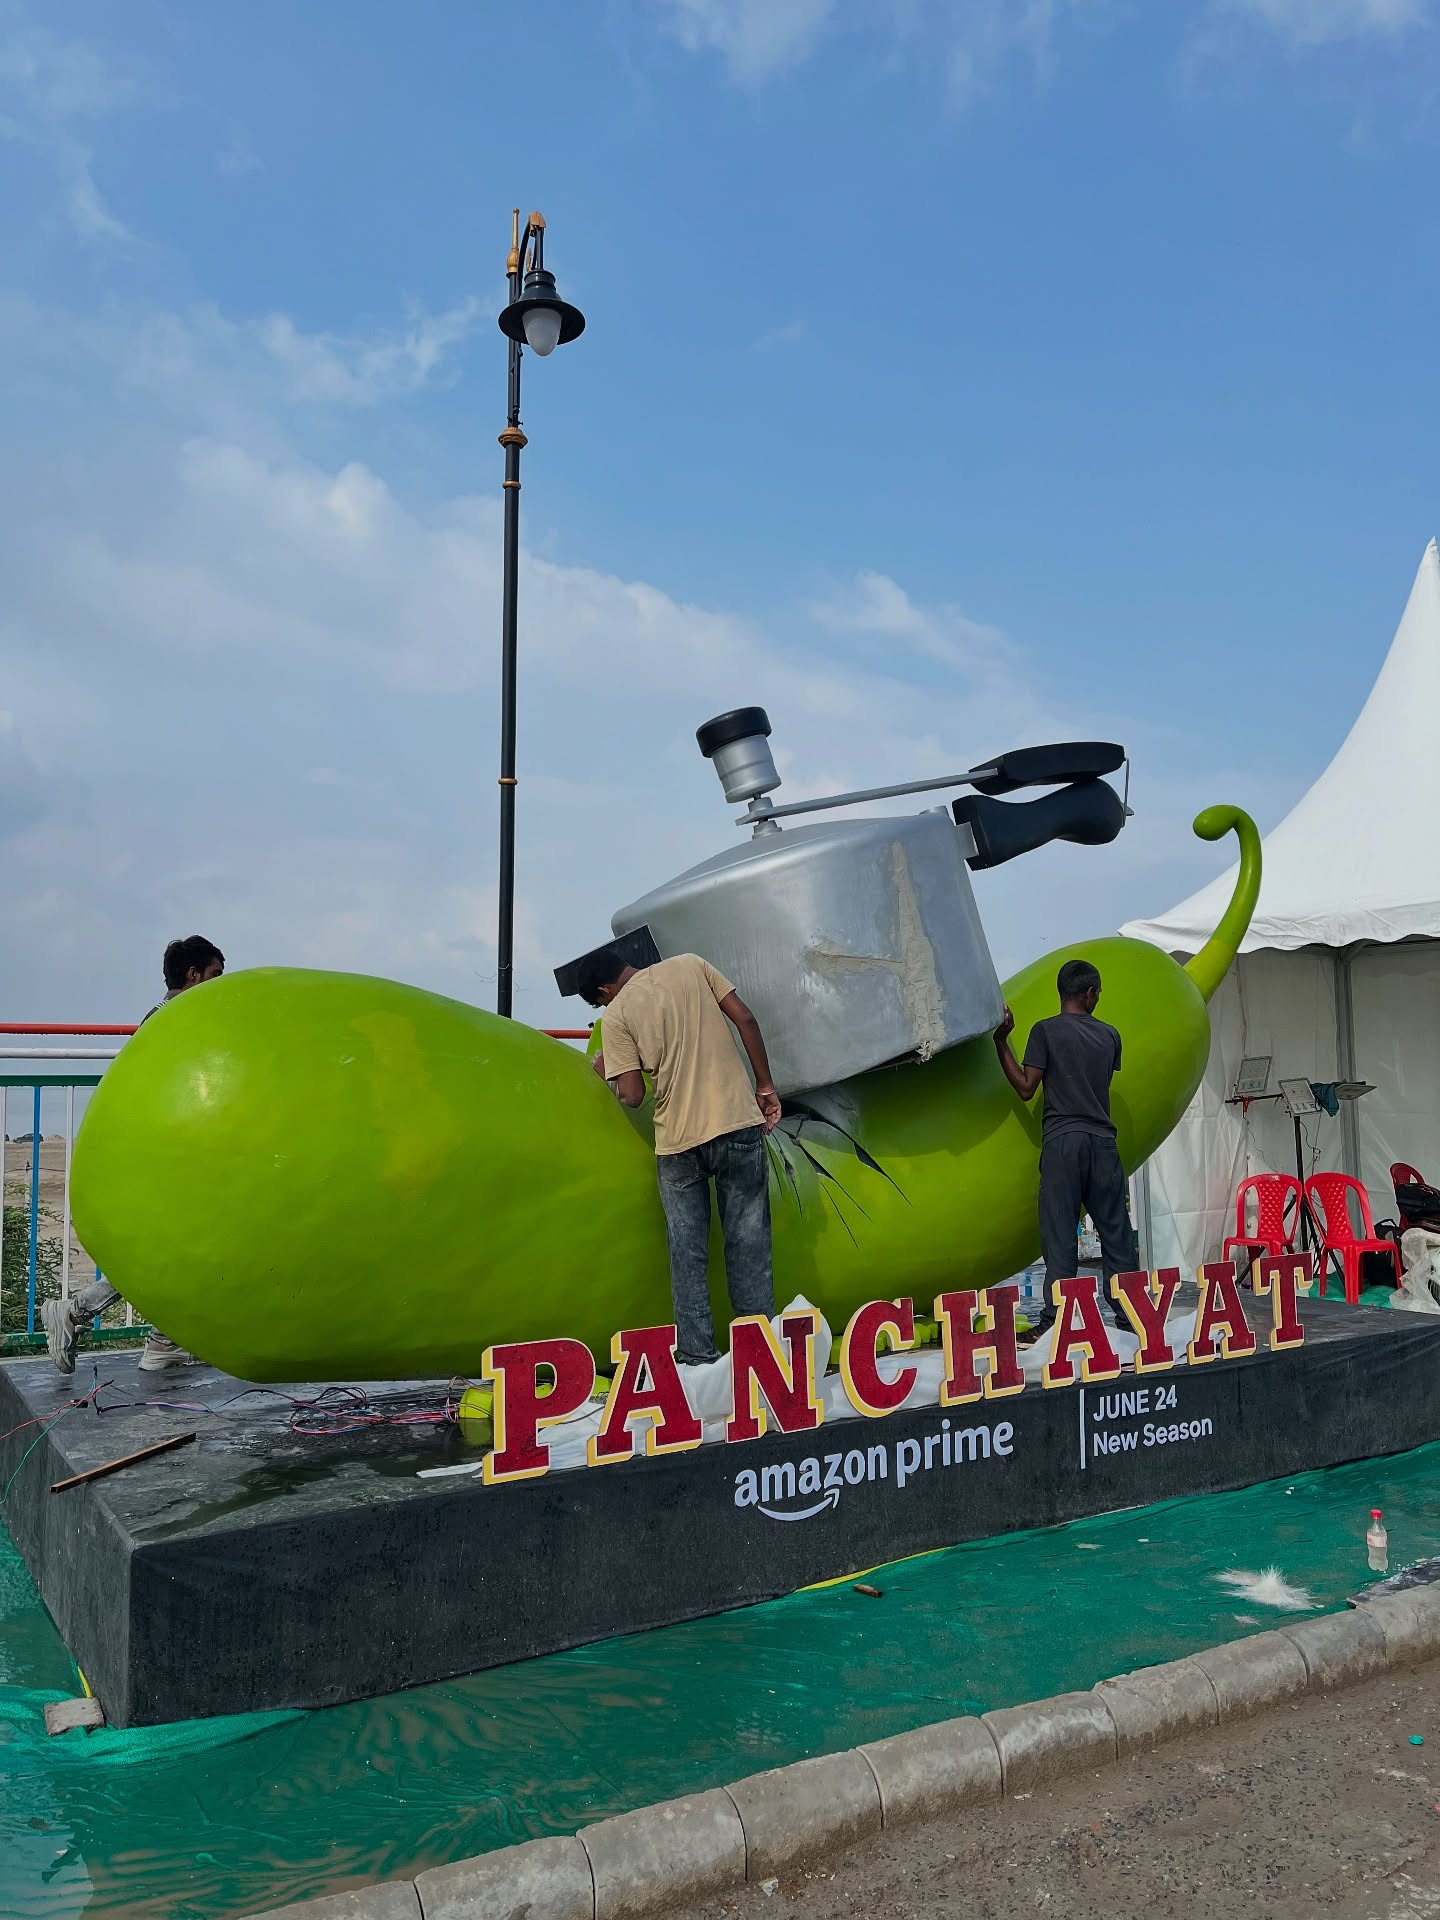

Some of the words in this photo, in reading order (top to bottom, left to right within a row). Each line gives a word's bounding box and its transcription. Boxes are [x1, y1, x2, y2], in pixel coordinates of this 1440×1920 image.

[482, 1252, 1313, 1485] PANCHAYAT
[1094, 1389, 1149, 1422] JUNE
[1155, 1384, 1178, 1411] 24
[734, 1443, 887, 1507] amazon
[896, 1419, 1015, 1488] prime
[1094, 1431, 1139, 1457] New
[1143, 1417, 1213, 1447] Season
